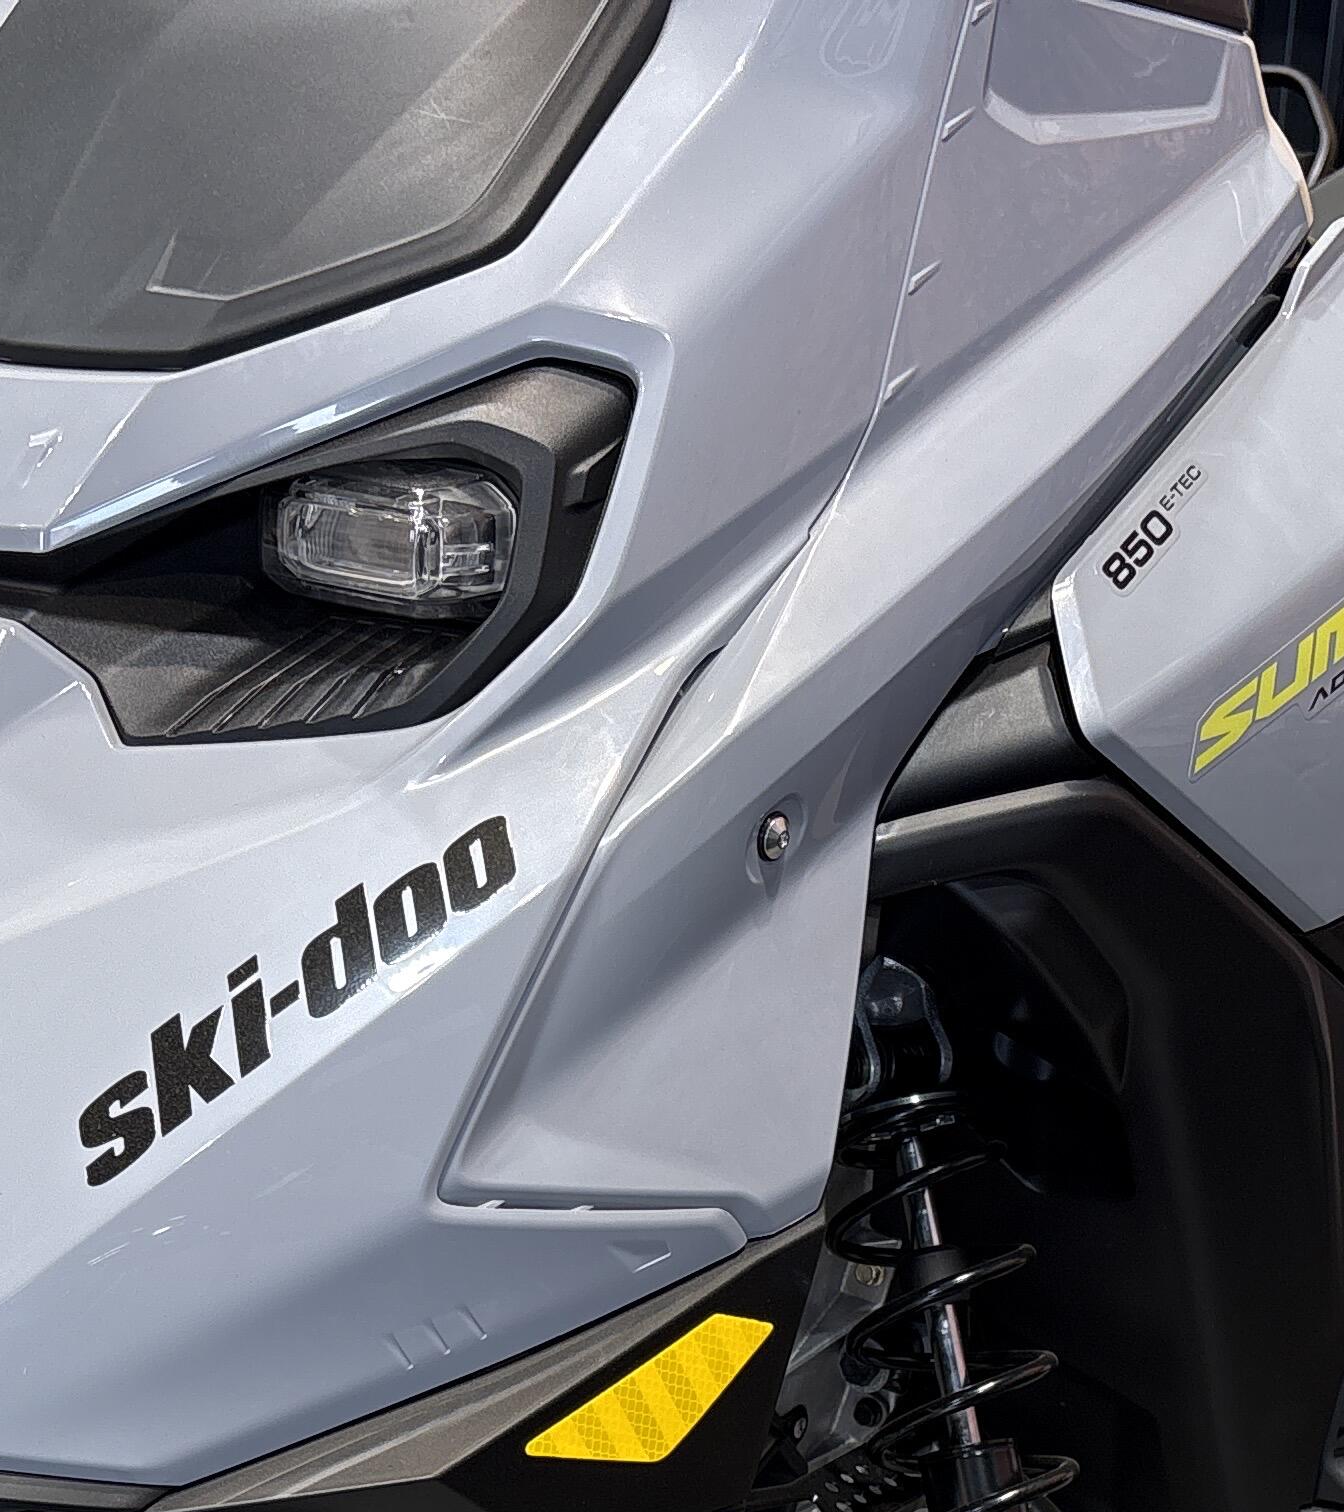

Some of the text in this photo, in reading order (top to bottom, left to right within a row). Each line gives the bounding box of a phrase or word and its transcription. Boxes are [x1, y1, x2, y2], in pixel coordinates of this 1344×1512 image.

[1102, 465, 1202, 590] 850 E-TEC
[78, 814, 518, 1188] ski-doo
